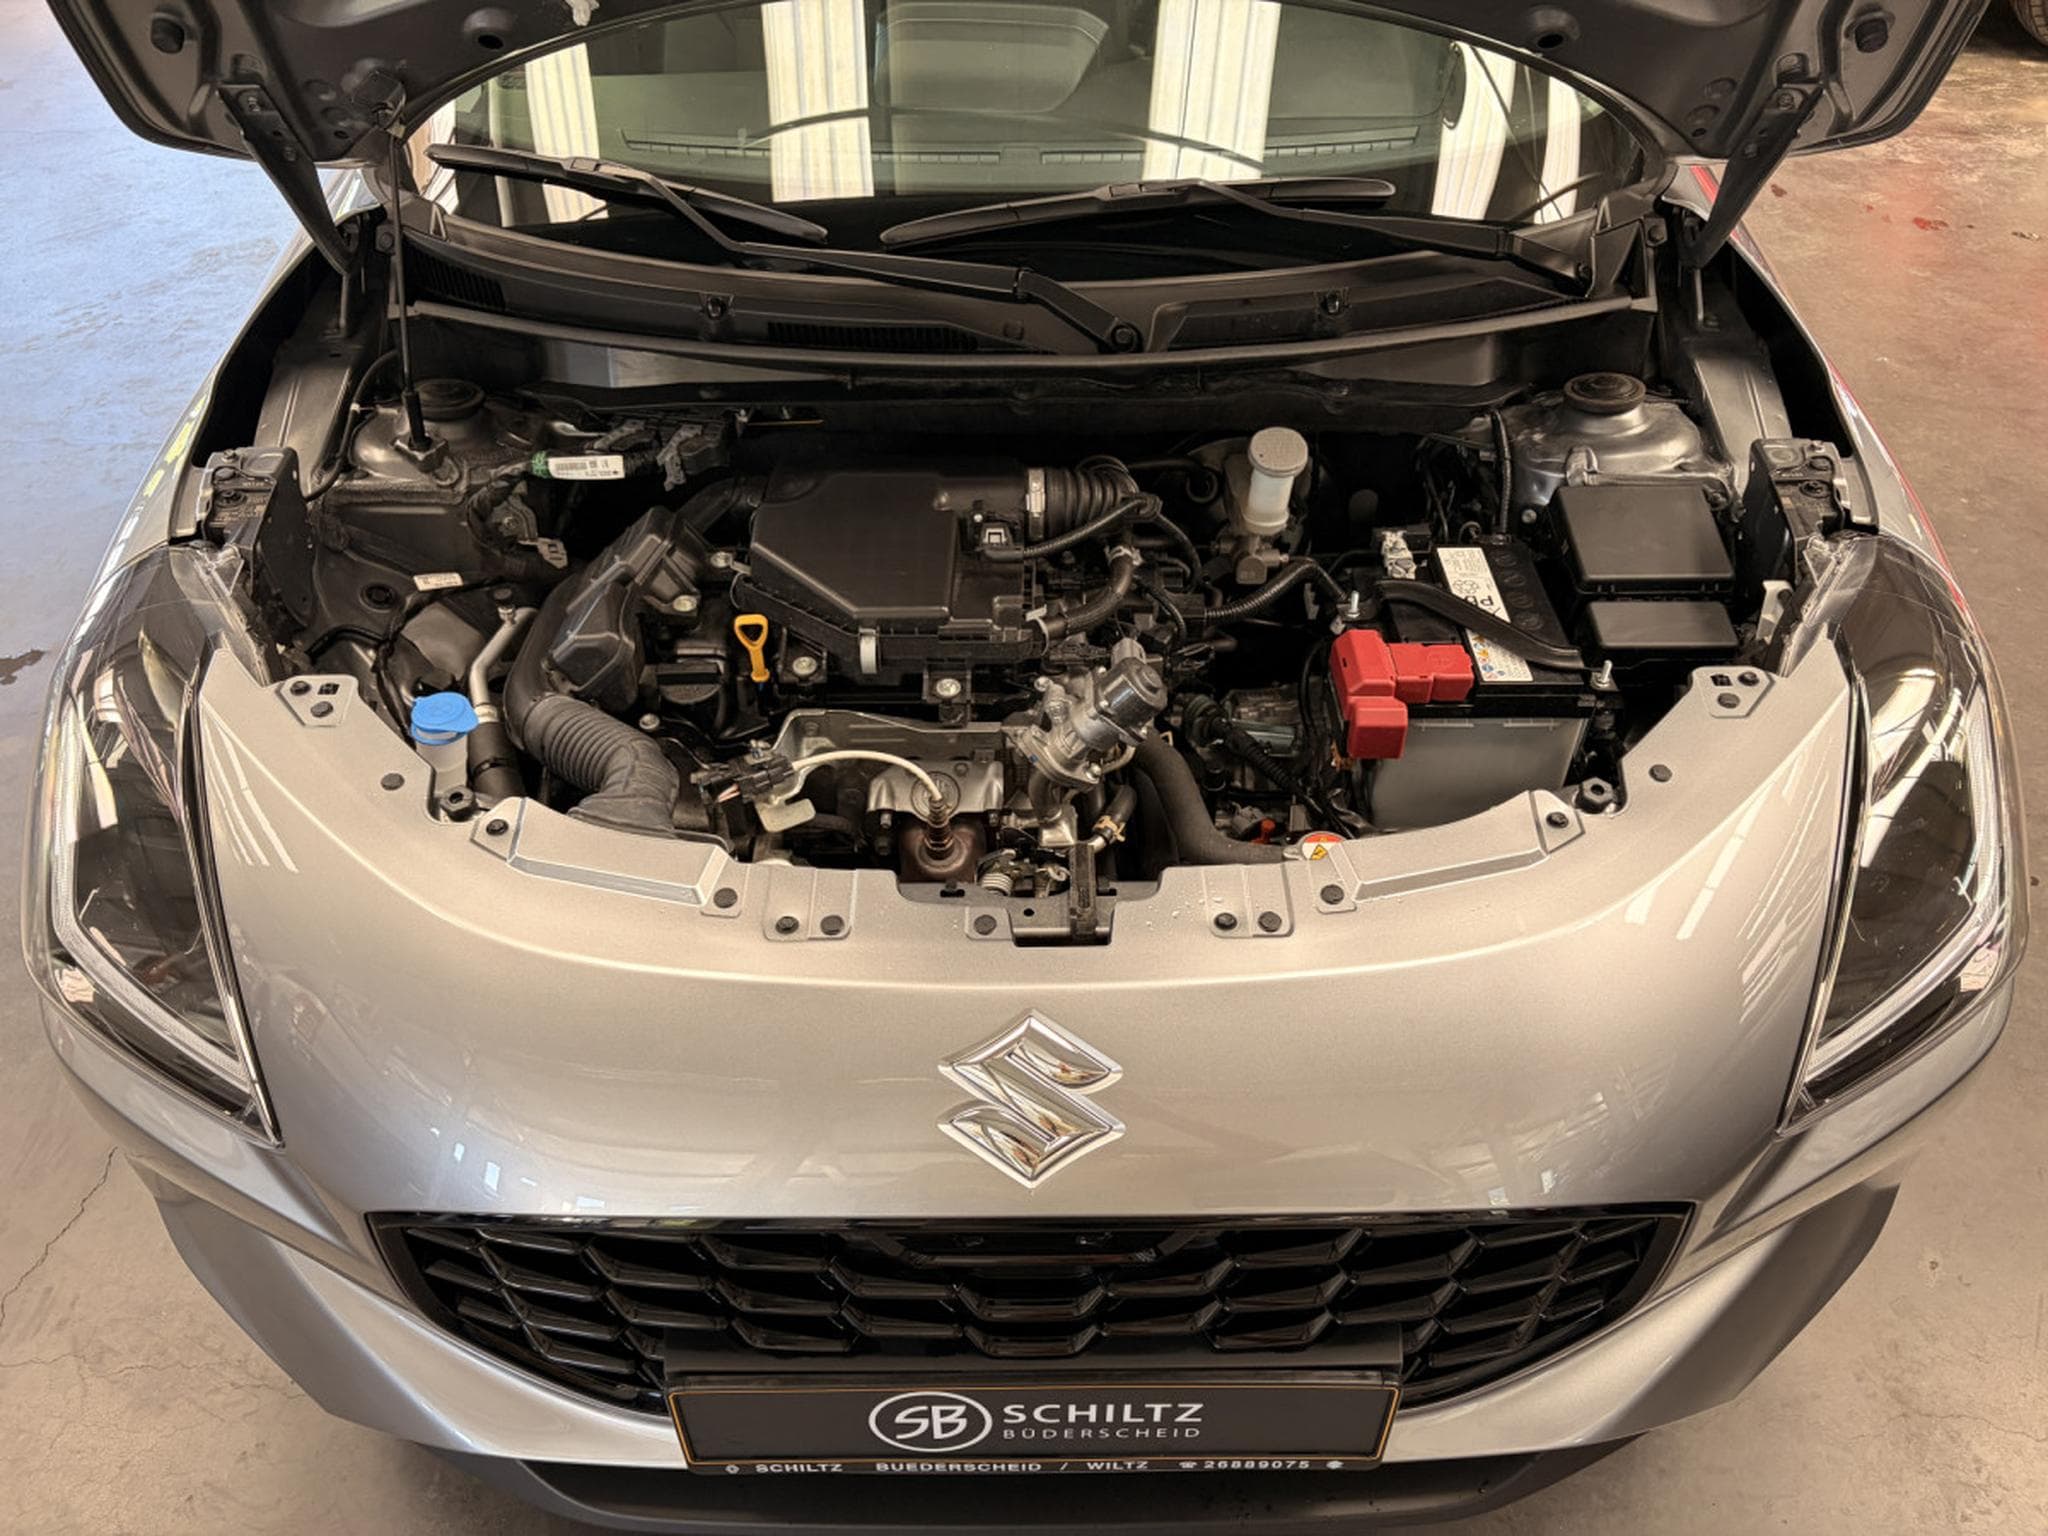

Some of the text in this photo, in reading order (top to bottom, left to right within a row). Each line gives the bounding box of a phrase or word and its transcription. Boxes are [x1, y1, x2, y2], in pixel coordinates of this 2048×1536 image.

[1003, 1403, 1204, 1424] SCHILTZ
[894, 1405, 968, 1440] SB
[1003, 1427, 1200, 1440] BÜDERSCHEID
[755, 1463, 843, 1474] SCHILTZ
[875, 1462, 1042, 1472] BUEDERSCHEID
[1087, 1461, 1148, 1470] WILTZ
